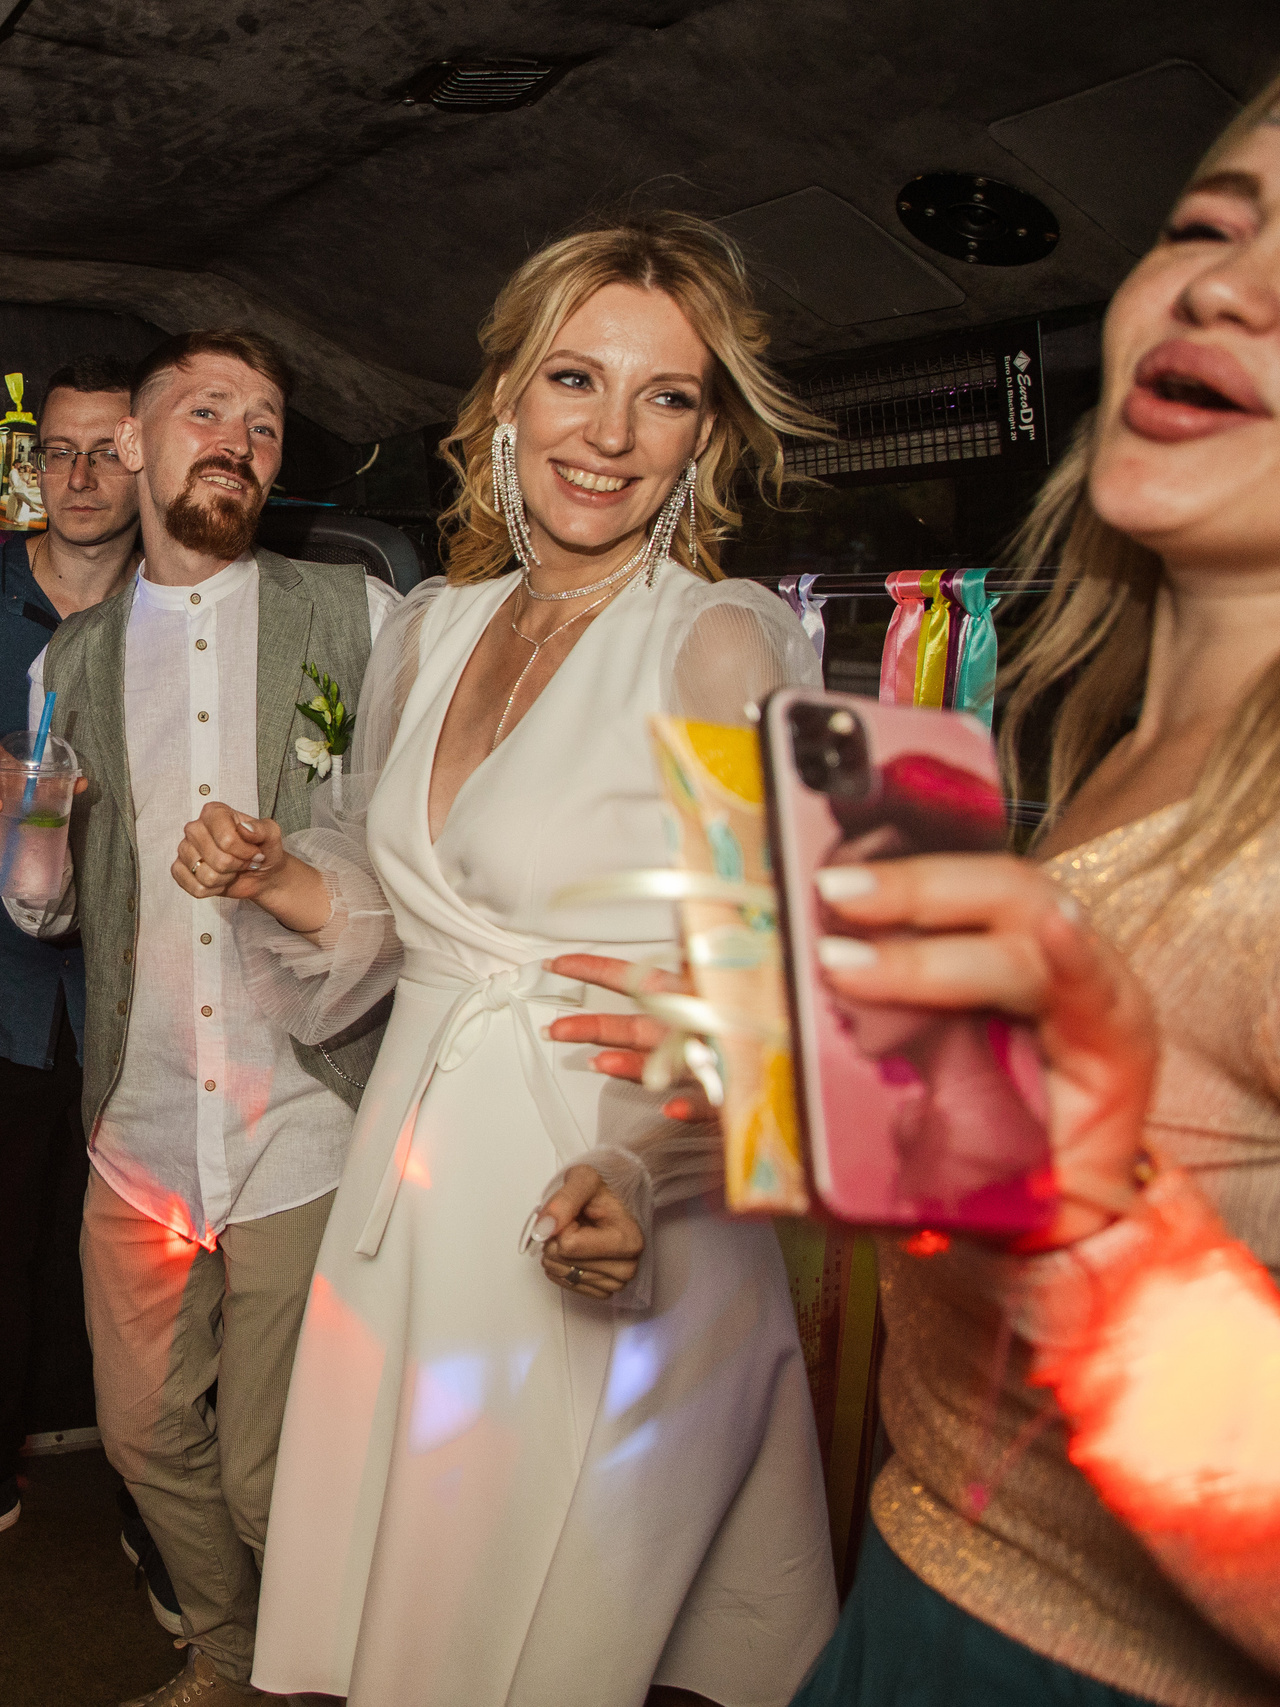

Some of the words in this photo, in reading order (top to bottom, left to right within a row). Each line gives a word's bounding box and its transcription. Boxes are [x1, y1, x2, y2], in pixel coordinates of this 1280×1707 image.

[1006, 376, 1013, 388] DJ
[1007, 389, 1016, 430] Blacklight
[1010, 431, 1017, 441] 20
